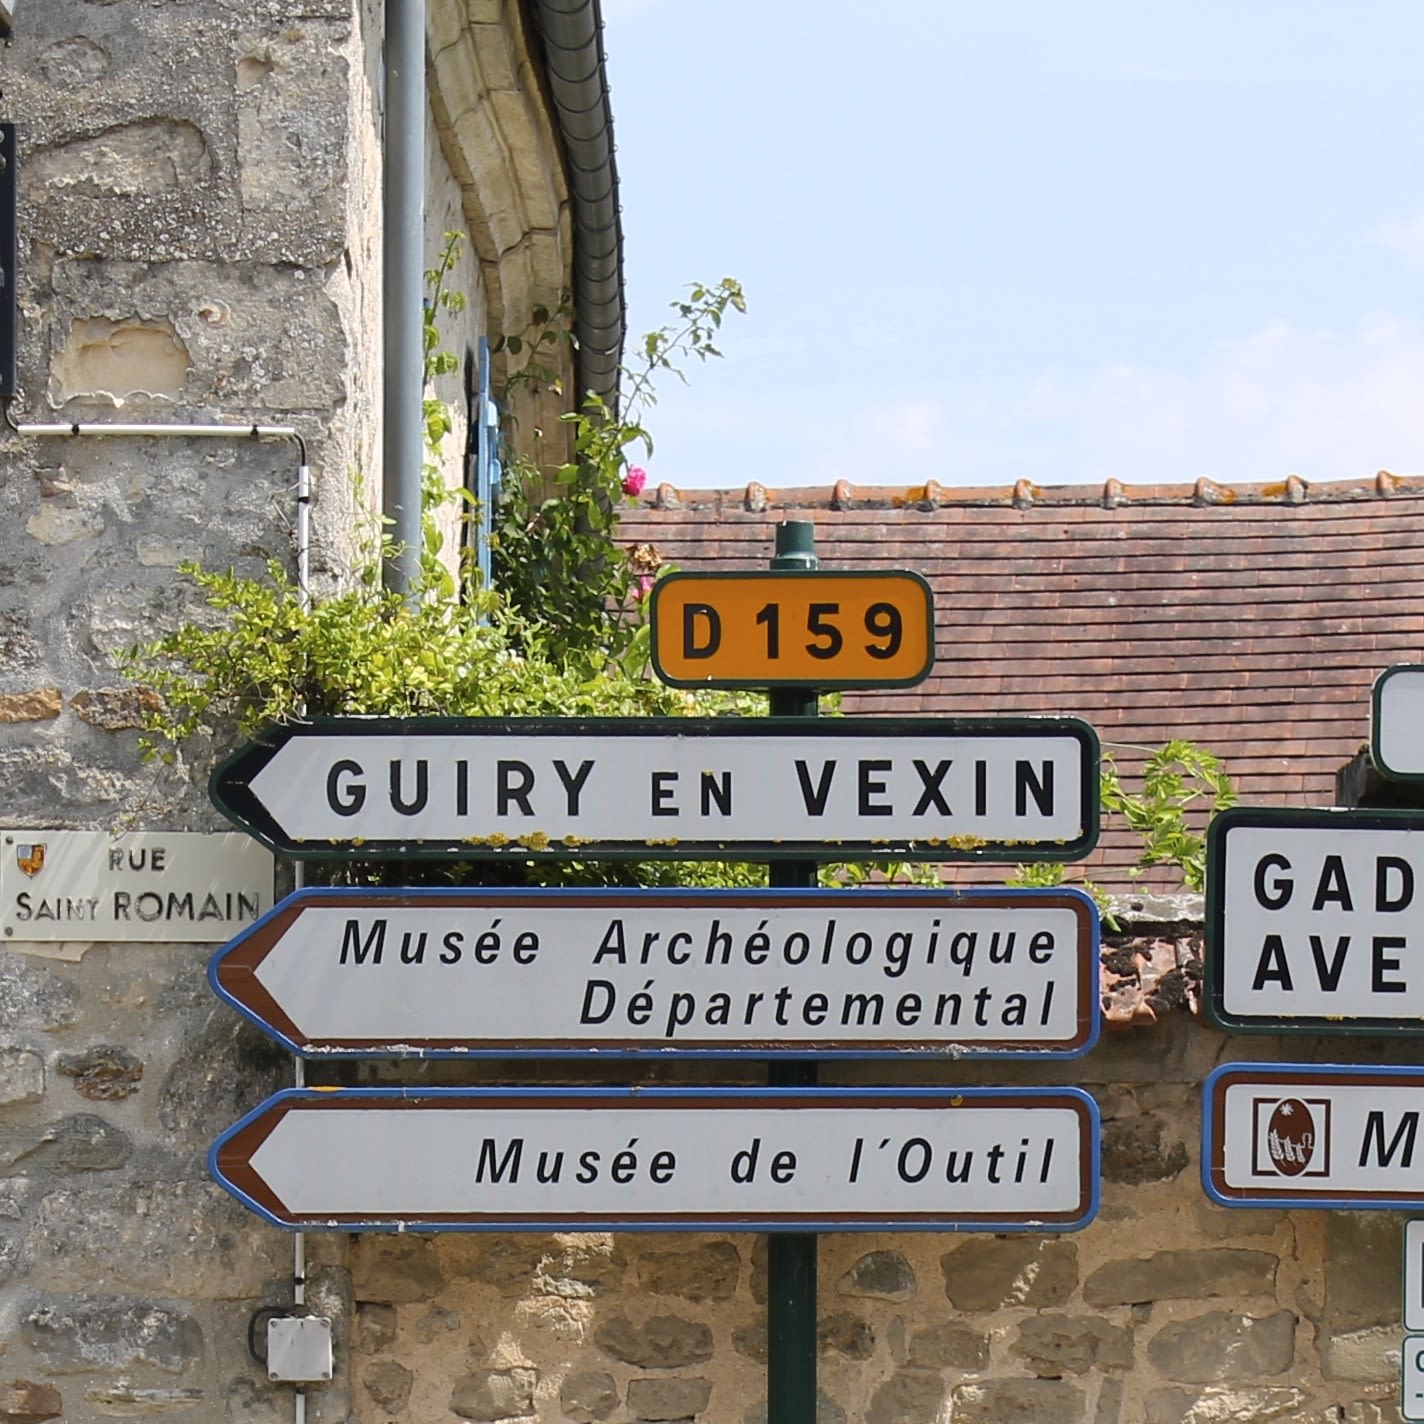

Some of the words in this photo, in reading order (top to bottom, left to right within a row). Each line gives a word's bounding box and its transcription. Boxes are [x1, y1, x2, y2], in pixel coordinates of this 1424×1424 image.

[682, 602, 722, 660] D
[756, 602, 903, 660] 159
[326, 759, 596, 817] GUIRY
[651, 771, 732, 817] EN
[794, 759, 1054, 817] VEXIN
[107, 847, 167, 872] RUE
[113, 890, 261, 923] ROMAIN
[339, 918, 539, 965] Musée
[592, 918, 1055, 976] Archéologique
[579, 978, 1055, 1037] Départemental
[475, 1138, 676, 1184] Musée
[730, 1138, 797, 1184] de
